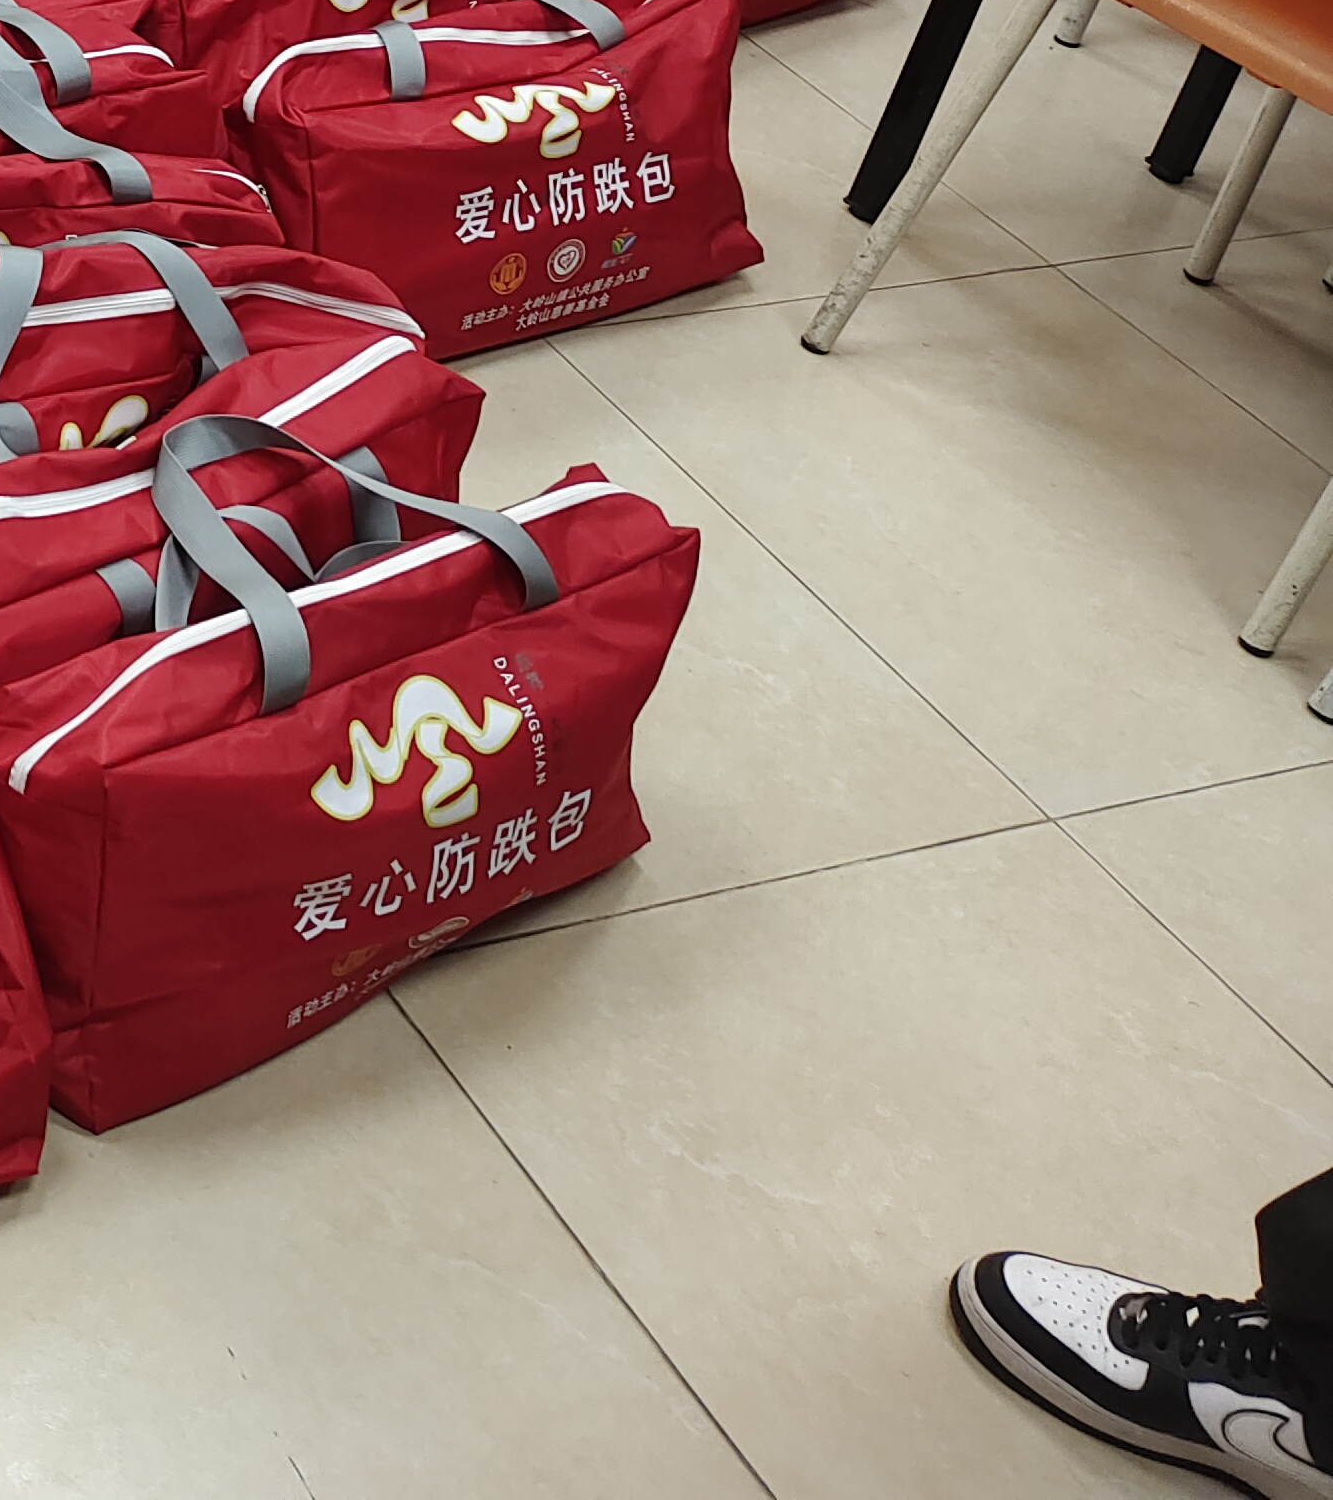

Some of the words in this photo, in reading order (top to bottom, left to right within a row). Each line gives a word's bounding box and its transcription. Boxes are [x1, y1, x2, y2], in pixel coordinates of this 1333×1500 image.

[455, 151, 676, 243] 爱心防跌包
[493, 656, 548, 786] DALINGSHAN
[292, 787, 592, 942] 爱心防跌包
